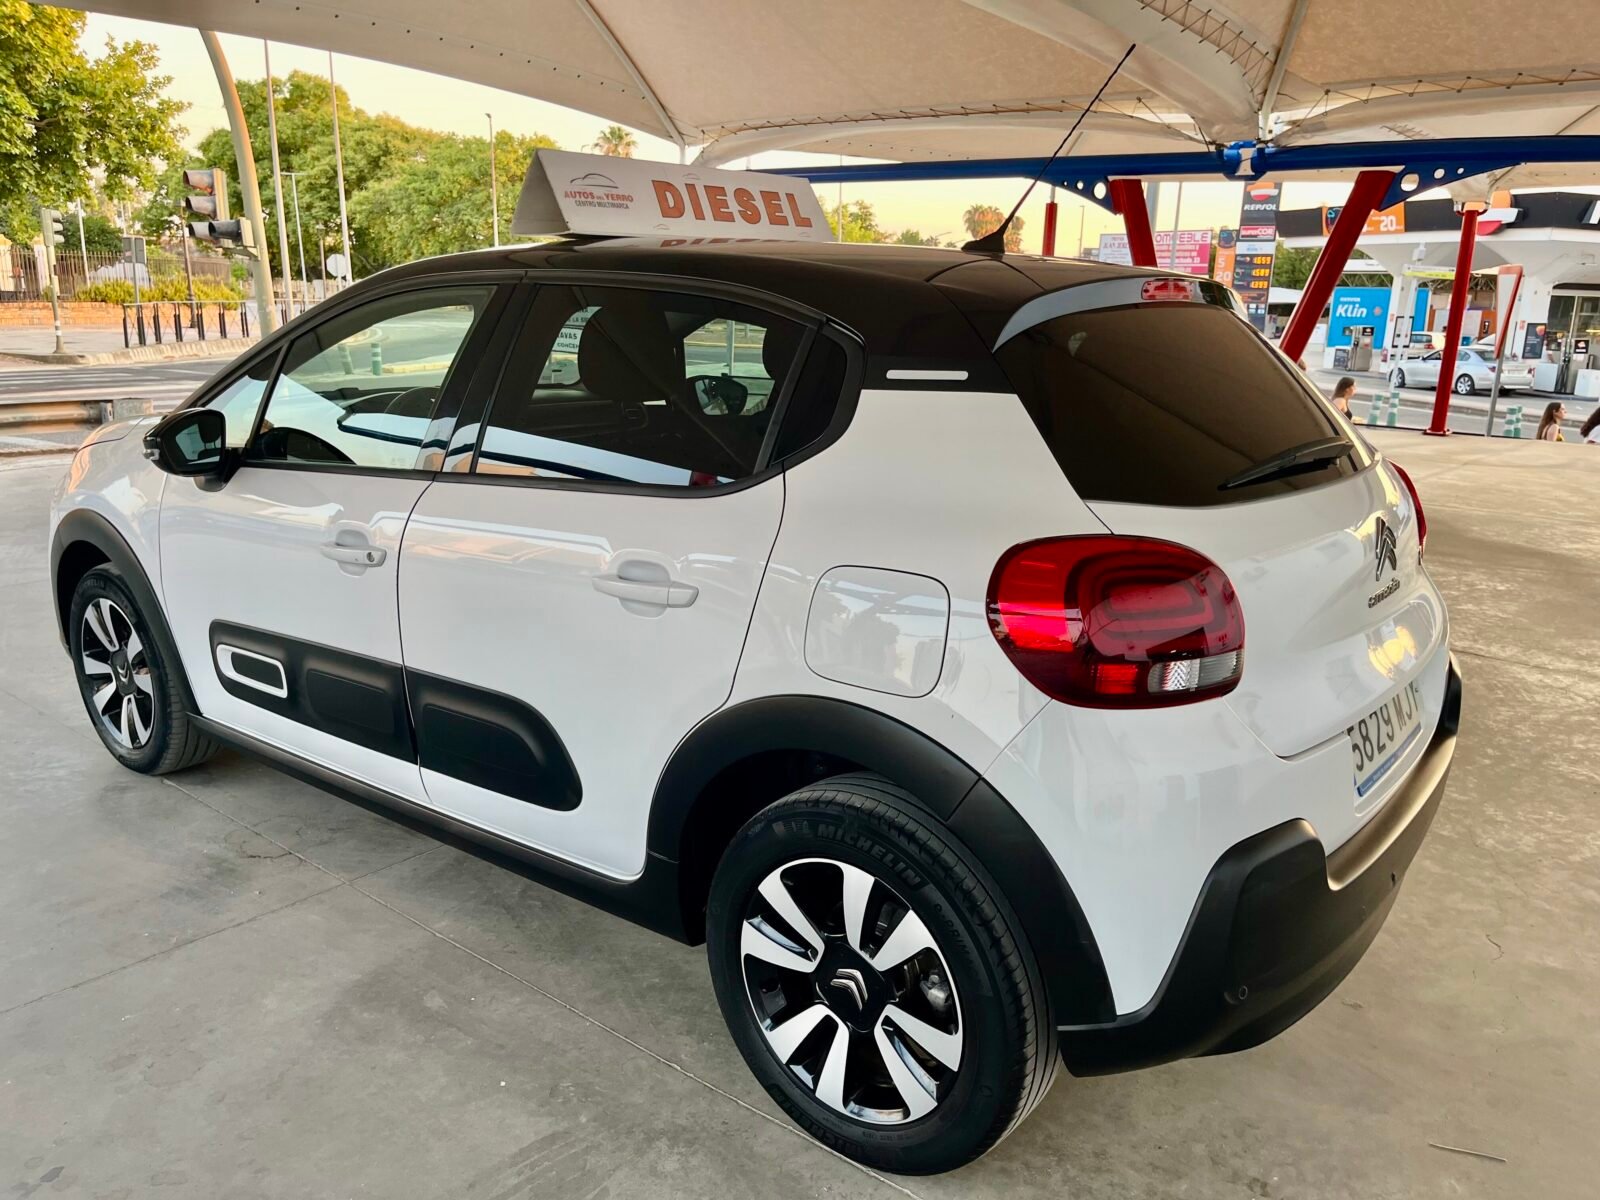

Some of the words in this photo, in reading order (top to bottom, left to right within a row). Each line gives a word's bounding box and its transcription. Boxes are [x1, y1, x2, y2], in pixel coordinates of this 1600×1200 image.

[564, 190, 595, 200] AUTOS
[604, 193, 634, 203] YERRO
[574, 199, 597, 208] CENTRO
[651, 179, 813, 228] DIESEL
[1243, 203, 1277, 211] REPSOL
[1380, 215, 1397, 232] 20
[1336, 304, 1367, 318] Klin
[1346, 703, 1395, 772] 5829
[1392, 680, 1419, 731] MJY
[816, 823, 924, 889] MICHELIN
